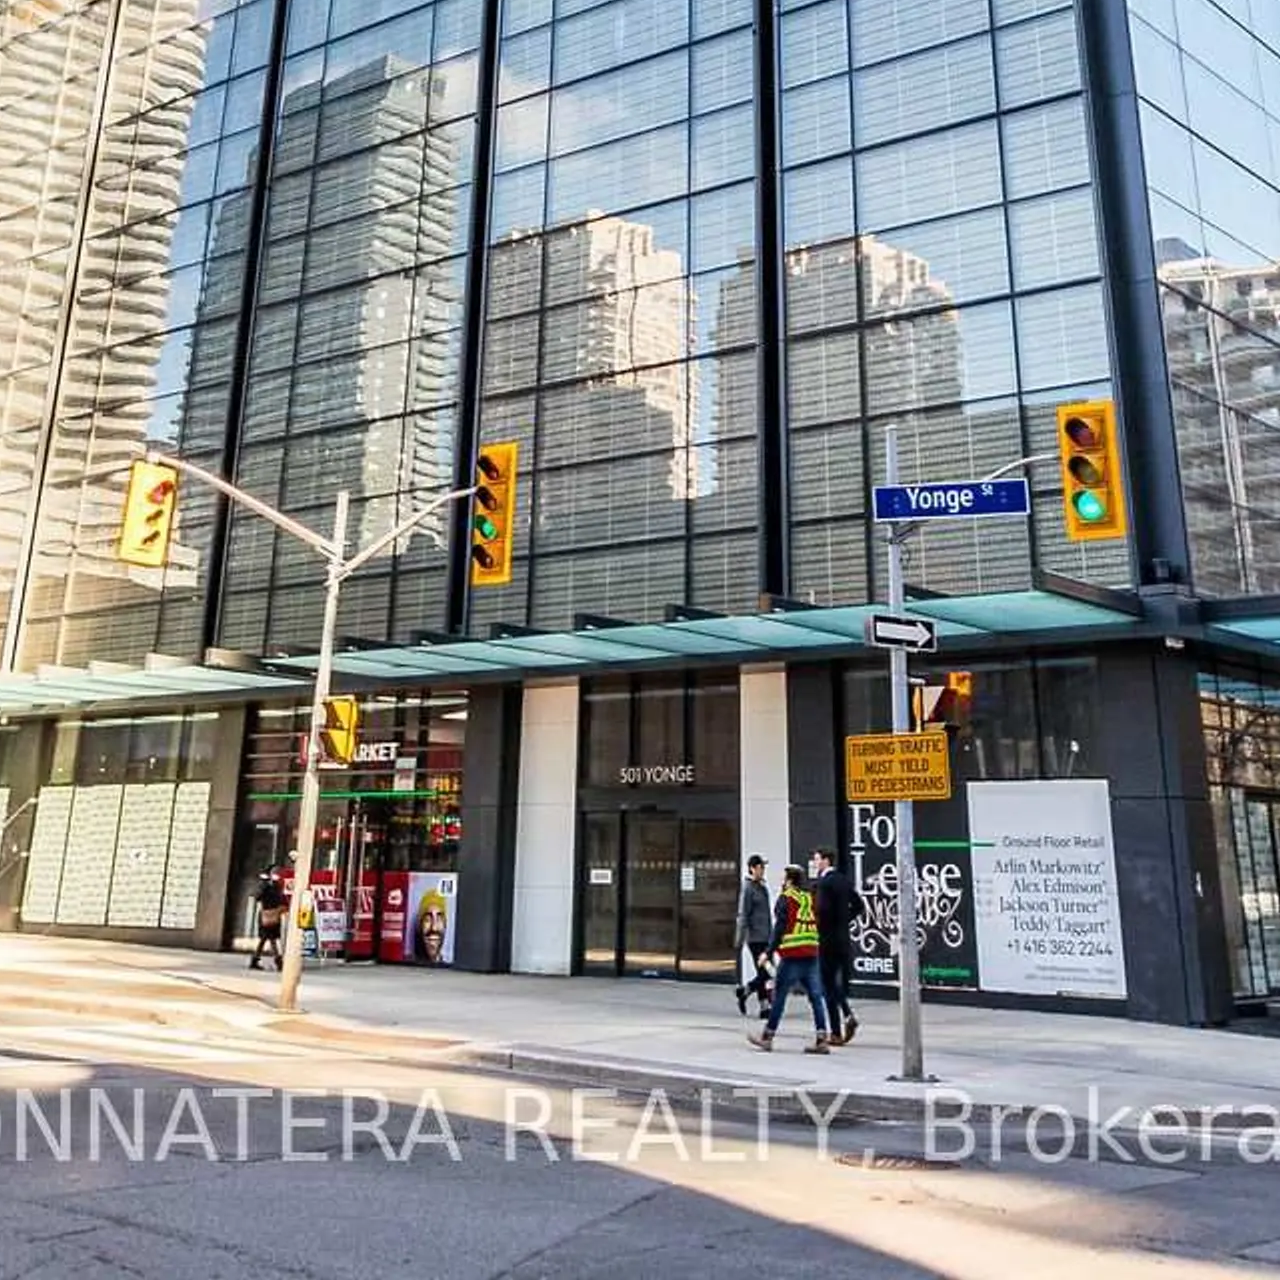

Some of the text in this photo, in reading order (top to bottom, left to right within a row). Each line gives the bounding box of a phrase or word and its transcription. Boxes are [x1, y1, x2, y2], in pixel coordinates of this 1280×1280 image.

[906, 484, 993, 513] Yonge St
[852, 738, 945, 756] TURNING TRAFFIC
[620, 766, 695, 783] 501 YONGE
[864, 758, 929, 775] MUST YIELD
[853, 776, 944, 793] TO PEDESTRIANS
[849, 804, 897, 848] Fo
[1002, 836, 1105, 848] Ground Floor Retail
[993, 858, 1027, 873] Arlin
[850, 851, 962, 898] Lese
[1010, 877, 1040, 893] Alex
[1000, 896, 1049, 913] Jackson
[1011, 916, 1050, 935] Teddy
[1007, 939, 1020, 954] +1
[1024, 939, 1046, 955] 416
[1078, 941, 1113, 957] 2244
[854, 957, 894, 973] CBRE
